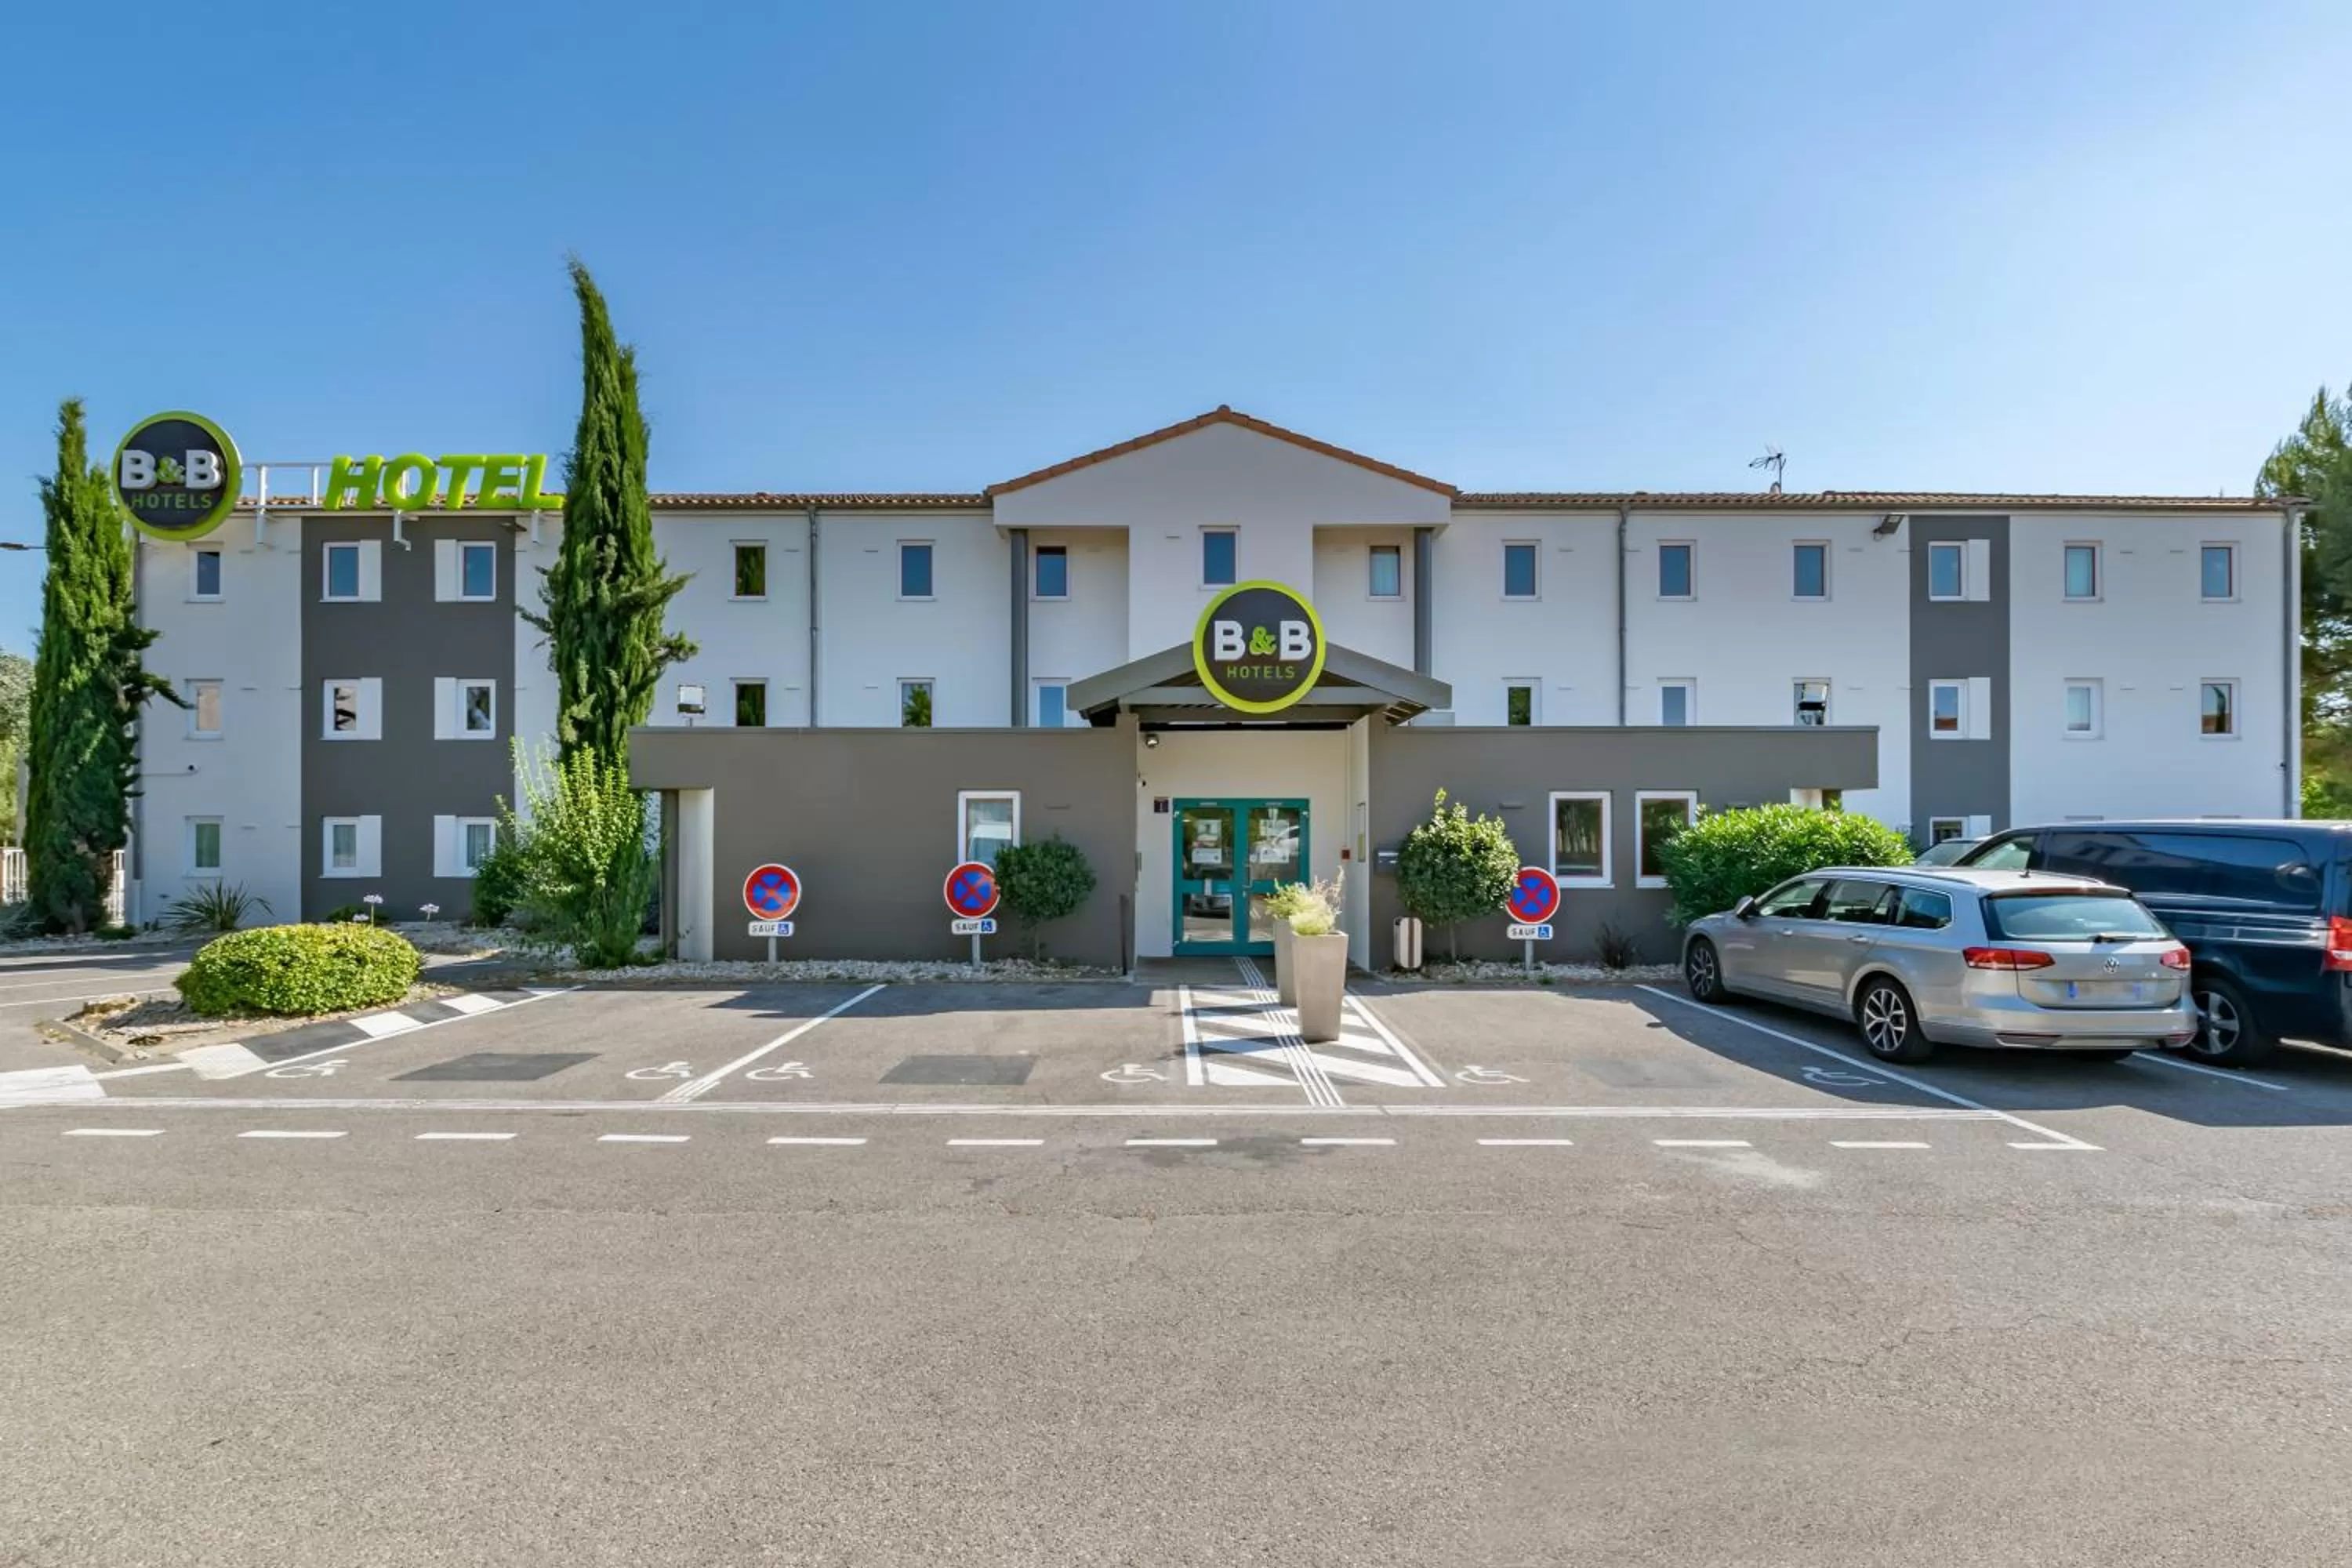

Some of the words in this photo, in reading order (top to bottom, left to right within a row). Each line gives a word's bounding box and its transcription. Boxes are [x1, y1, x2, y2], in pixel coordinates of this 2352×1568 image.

[122, 449, 222, 490] B&B
[322, 452, 564, 510] HOTEL
[131, 493, 212, 509] HOTELS
[1214, 620, 1312, 661] B&B
[1227, 666, 1296, 679] HOTELS
[751, 924, 775, 933] SAUF
[955, 922, 979, 931] SAUF
[1512, 927, 1536, 936] SAUF
